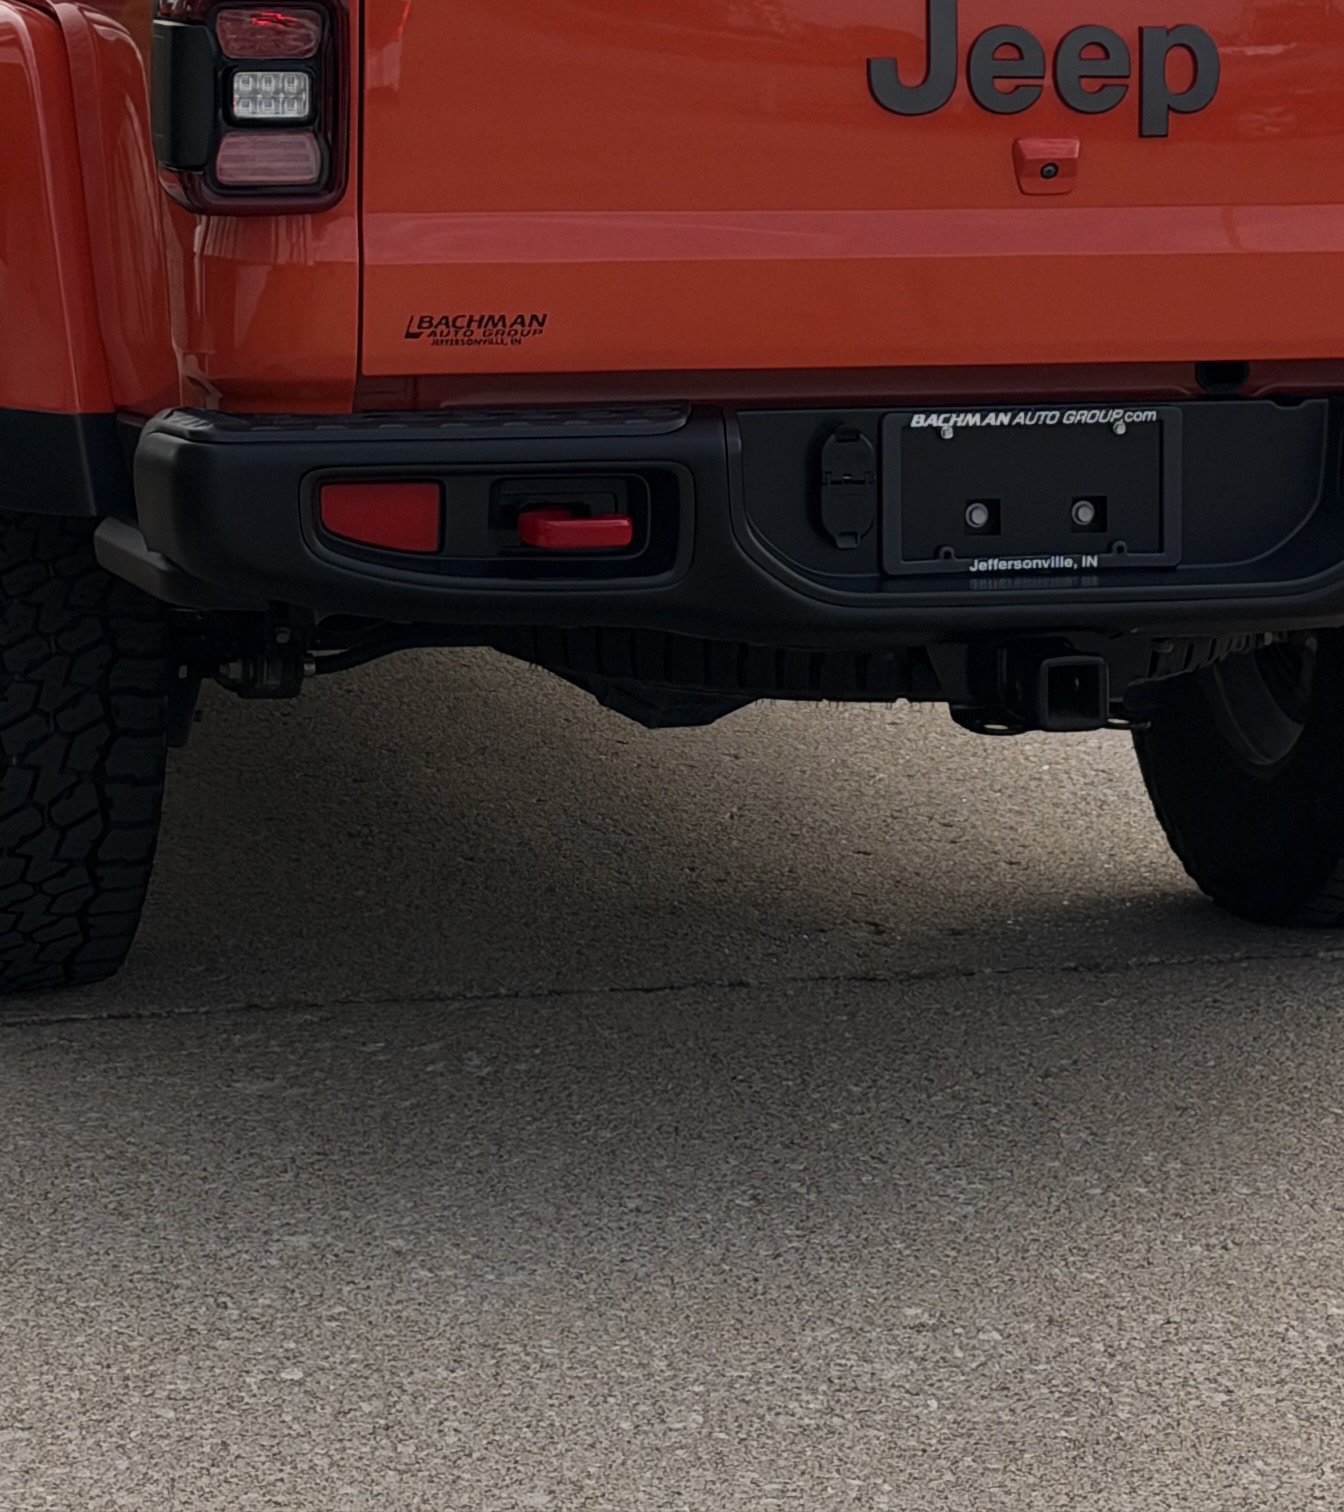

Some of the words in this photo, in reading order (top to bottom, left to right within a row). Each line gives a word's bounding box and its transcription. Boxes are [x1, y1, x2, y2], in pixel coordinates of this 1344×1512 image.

[416, 313, 548, 330] BACHMAN
[427, 329, 475, 338] AUTO
[482, 328, 544, 337] GROUP
[910, 410, 1011, 428] BACHMAN
[1012, 410, 1058, 425] AUTO
[969, 557, 1078, 572] Jeffersonville,
[1081, 555, 1098, 568] IN
